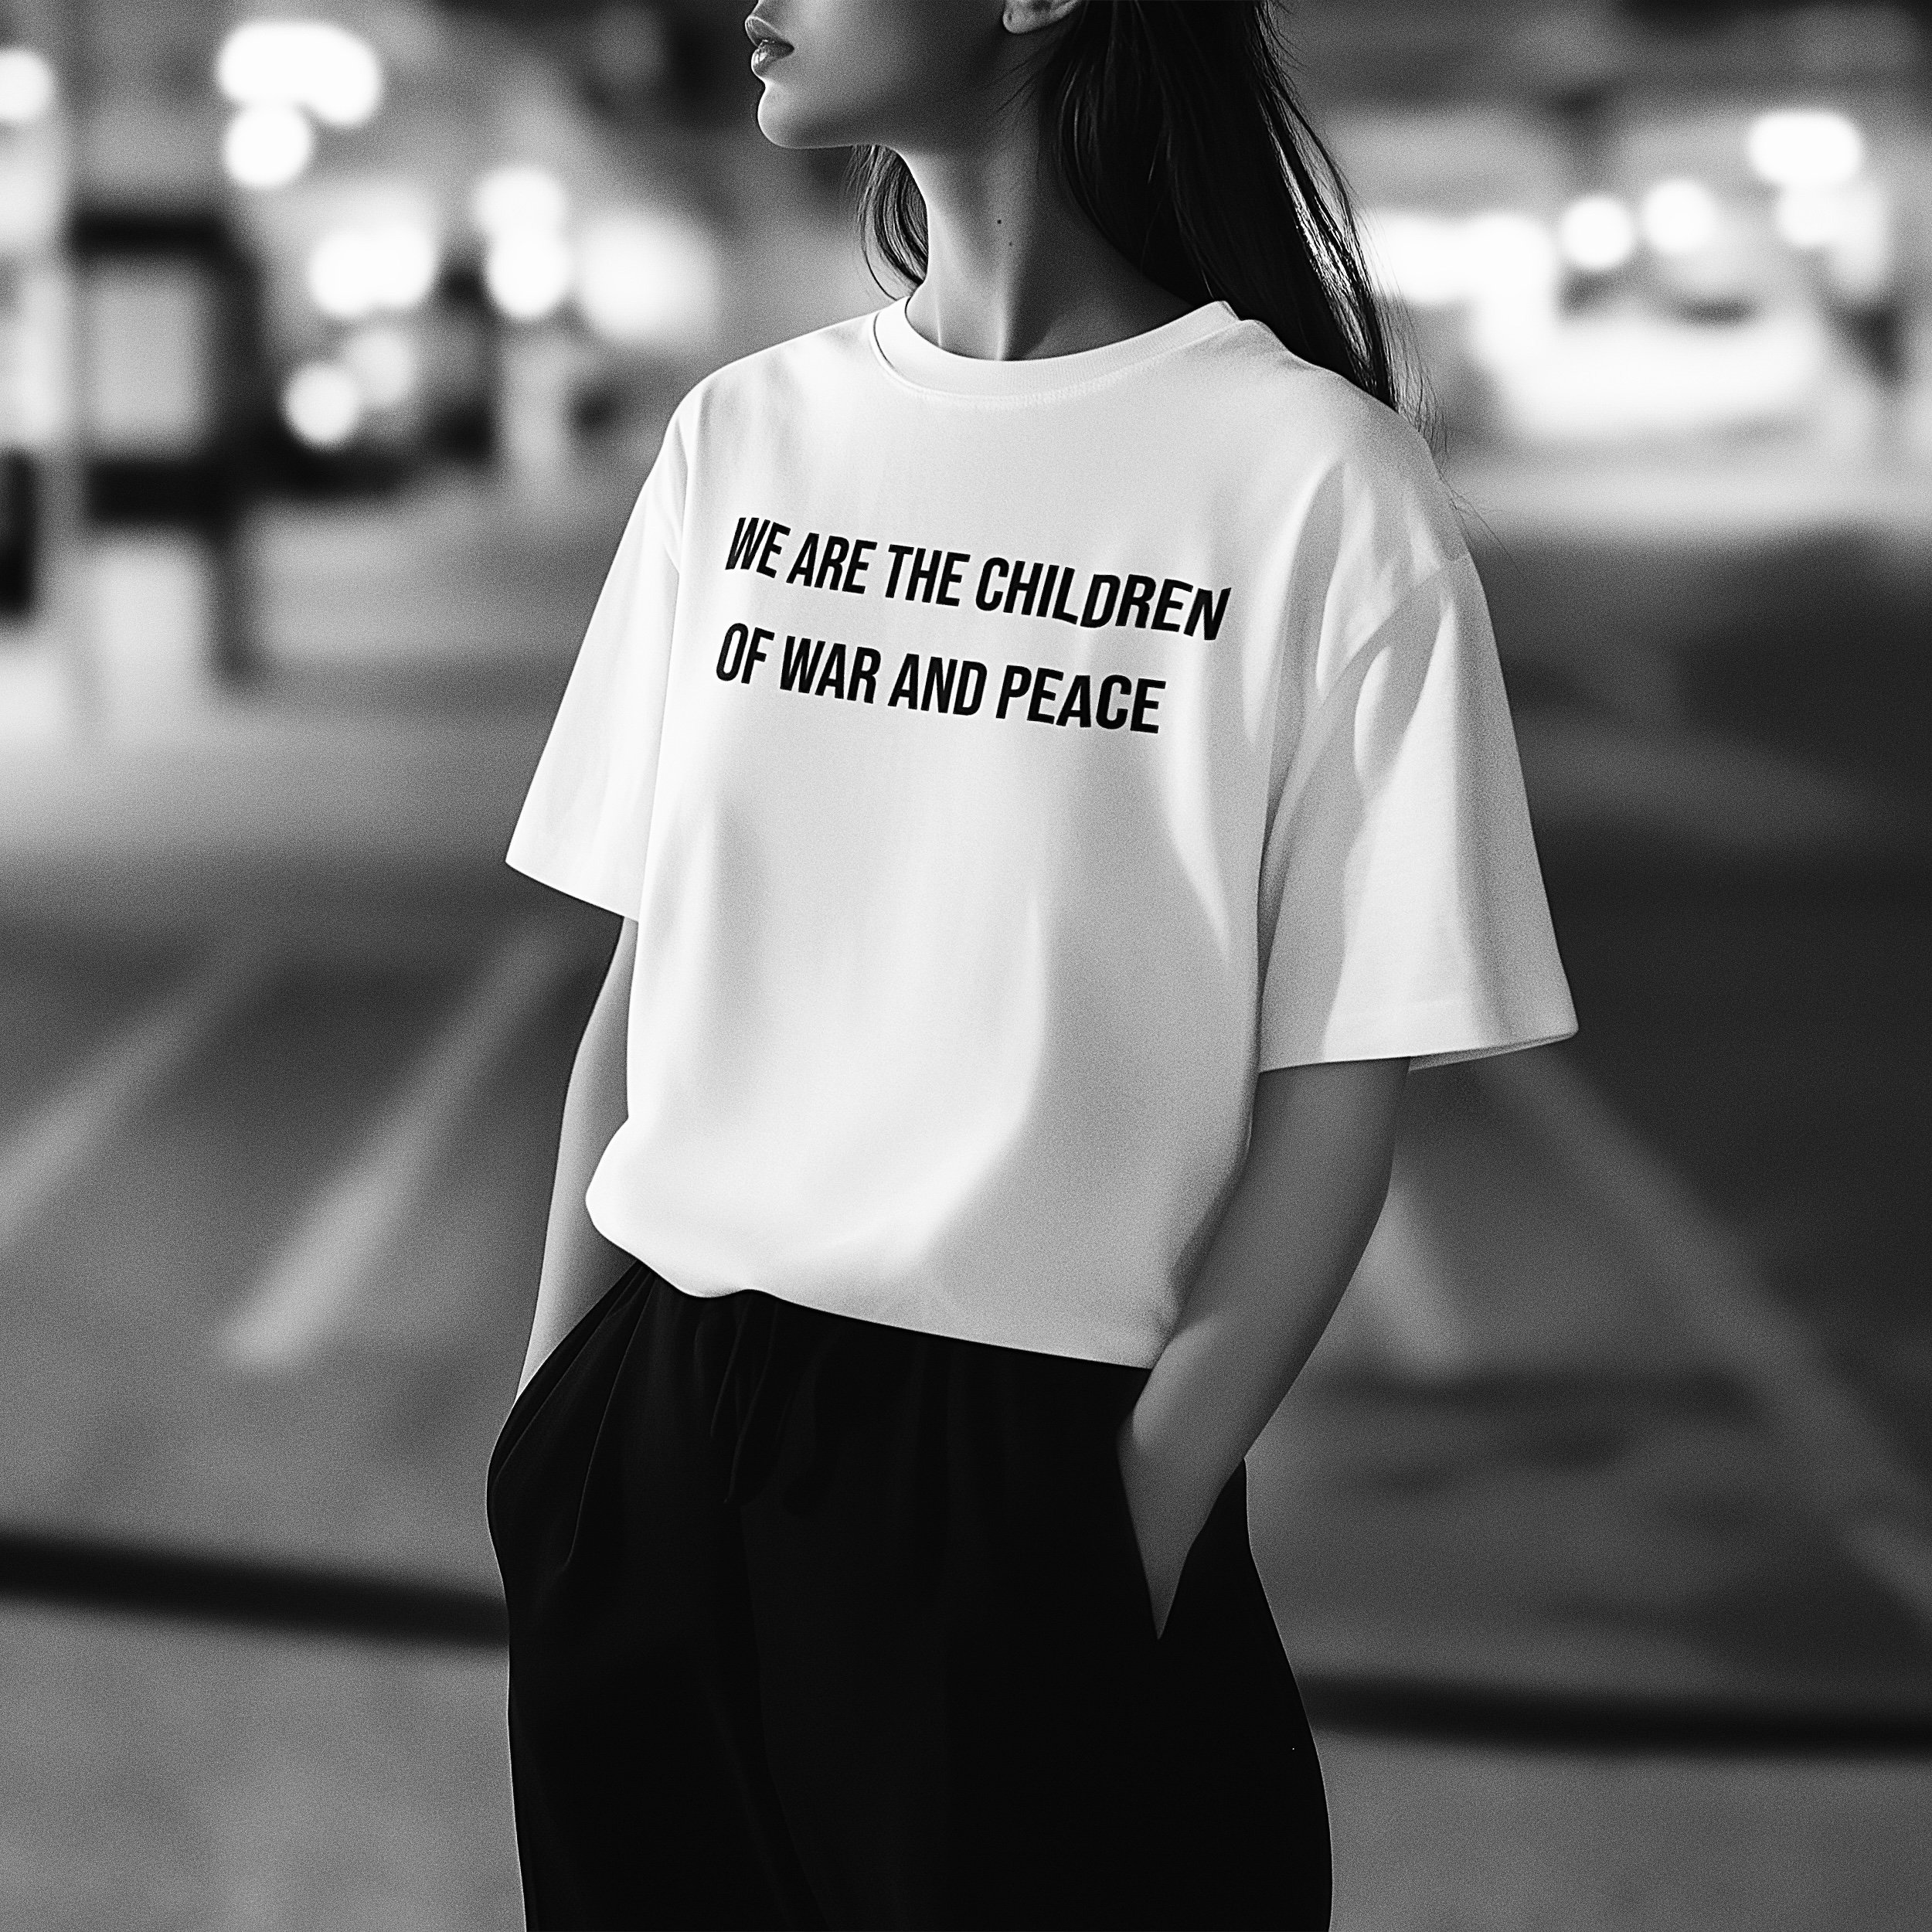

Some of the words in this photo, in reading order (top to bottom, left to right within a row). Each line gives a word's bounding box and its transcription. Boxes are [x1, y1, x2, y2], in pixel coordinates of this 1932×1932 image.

[725, 517, 791, 579] WE
[785, 532, 878, 594] ARE
[885, 544, 971, 607] THE
[975, 556, 1232, 641] CHILDREN
[716, 622, 775, 685] OF
[779, 635, 882, 705] WAR
[887, 653, 988, 716] AND
[995, 665, 1166, 734] PEACE
